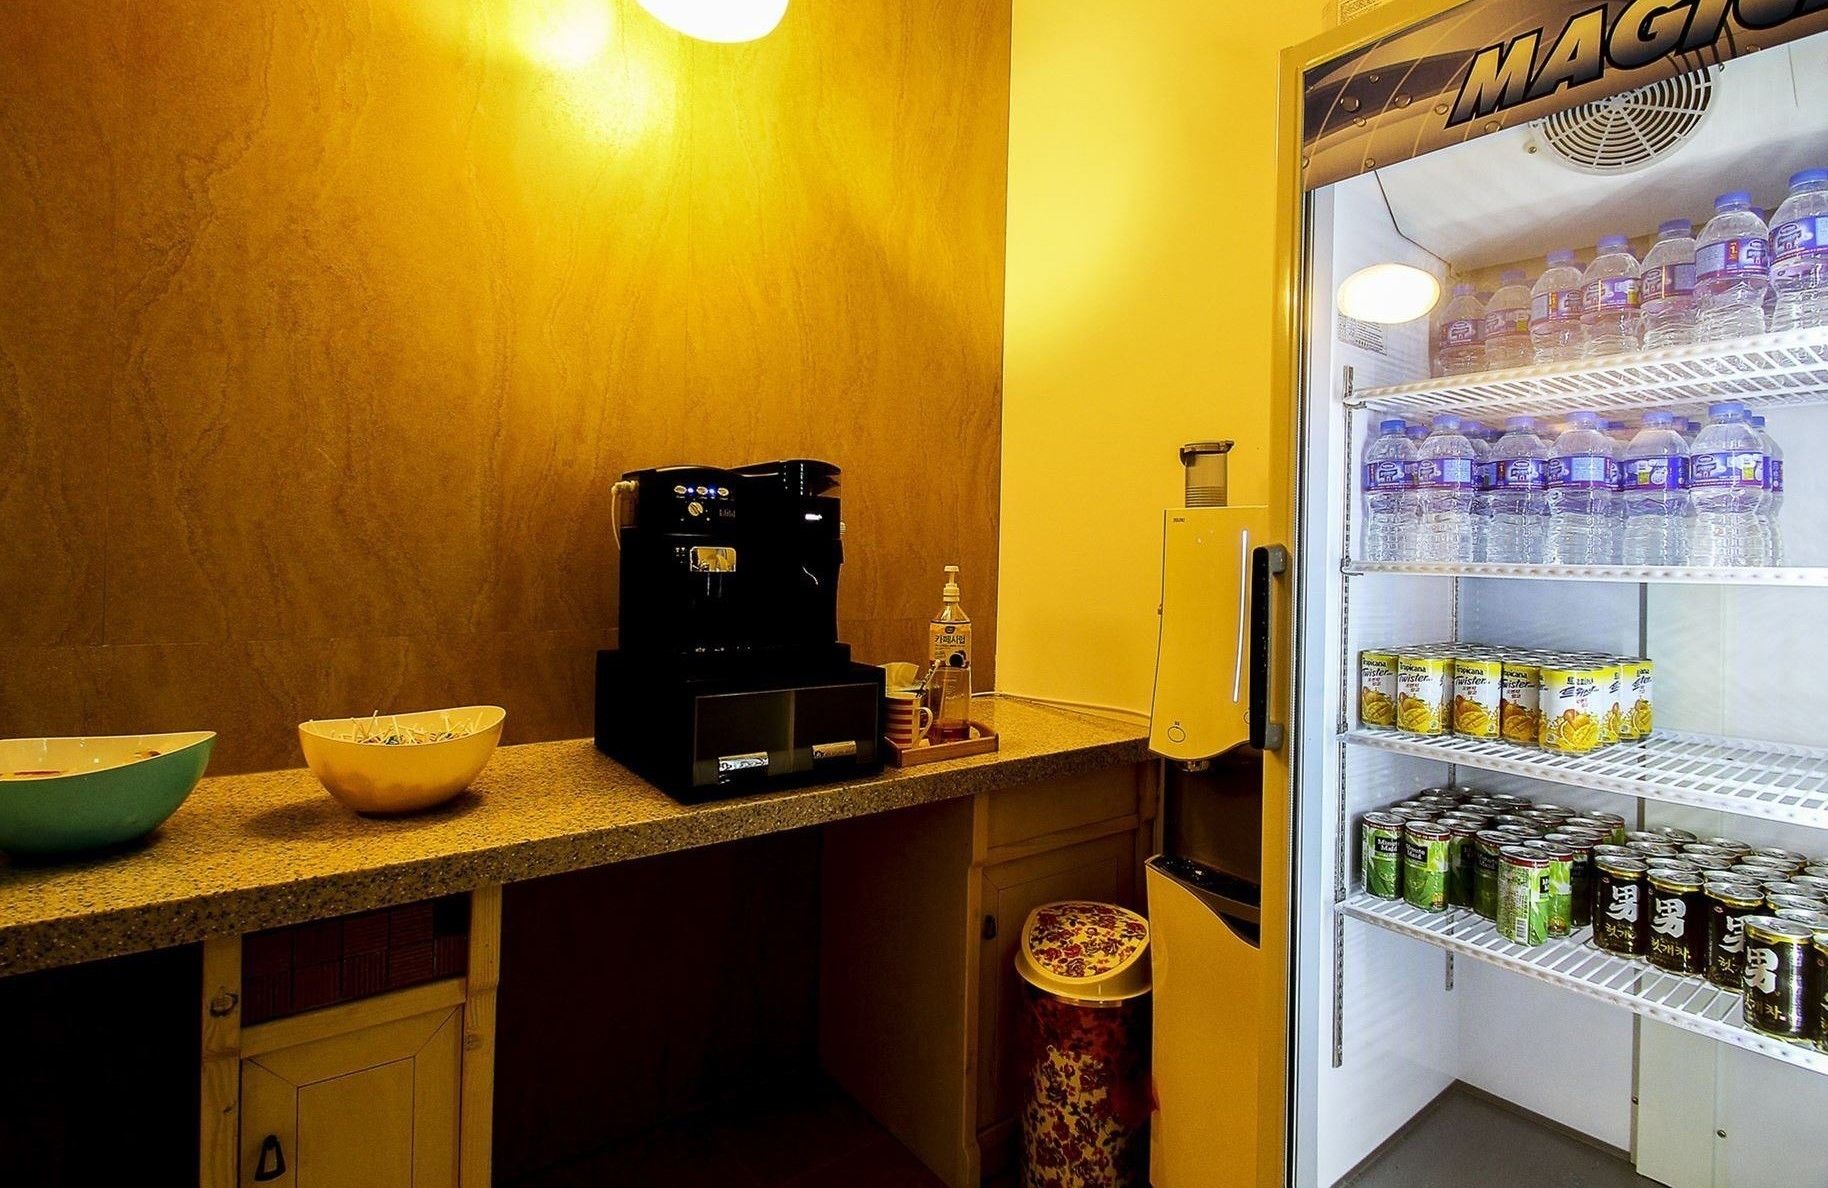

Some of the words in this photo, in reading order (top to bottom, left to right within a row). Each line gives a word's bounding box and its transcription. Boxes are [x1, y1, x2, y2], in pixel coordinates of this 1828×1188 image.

[1605, 884, 1638, 923] 男
[1650, 898, 1687, 938] 男
[1743, 945, 1779, 994] 男
